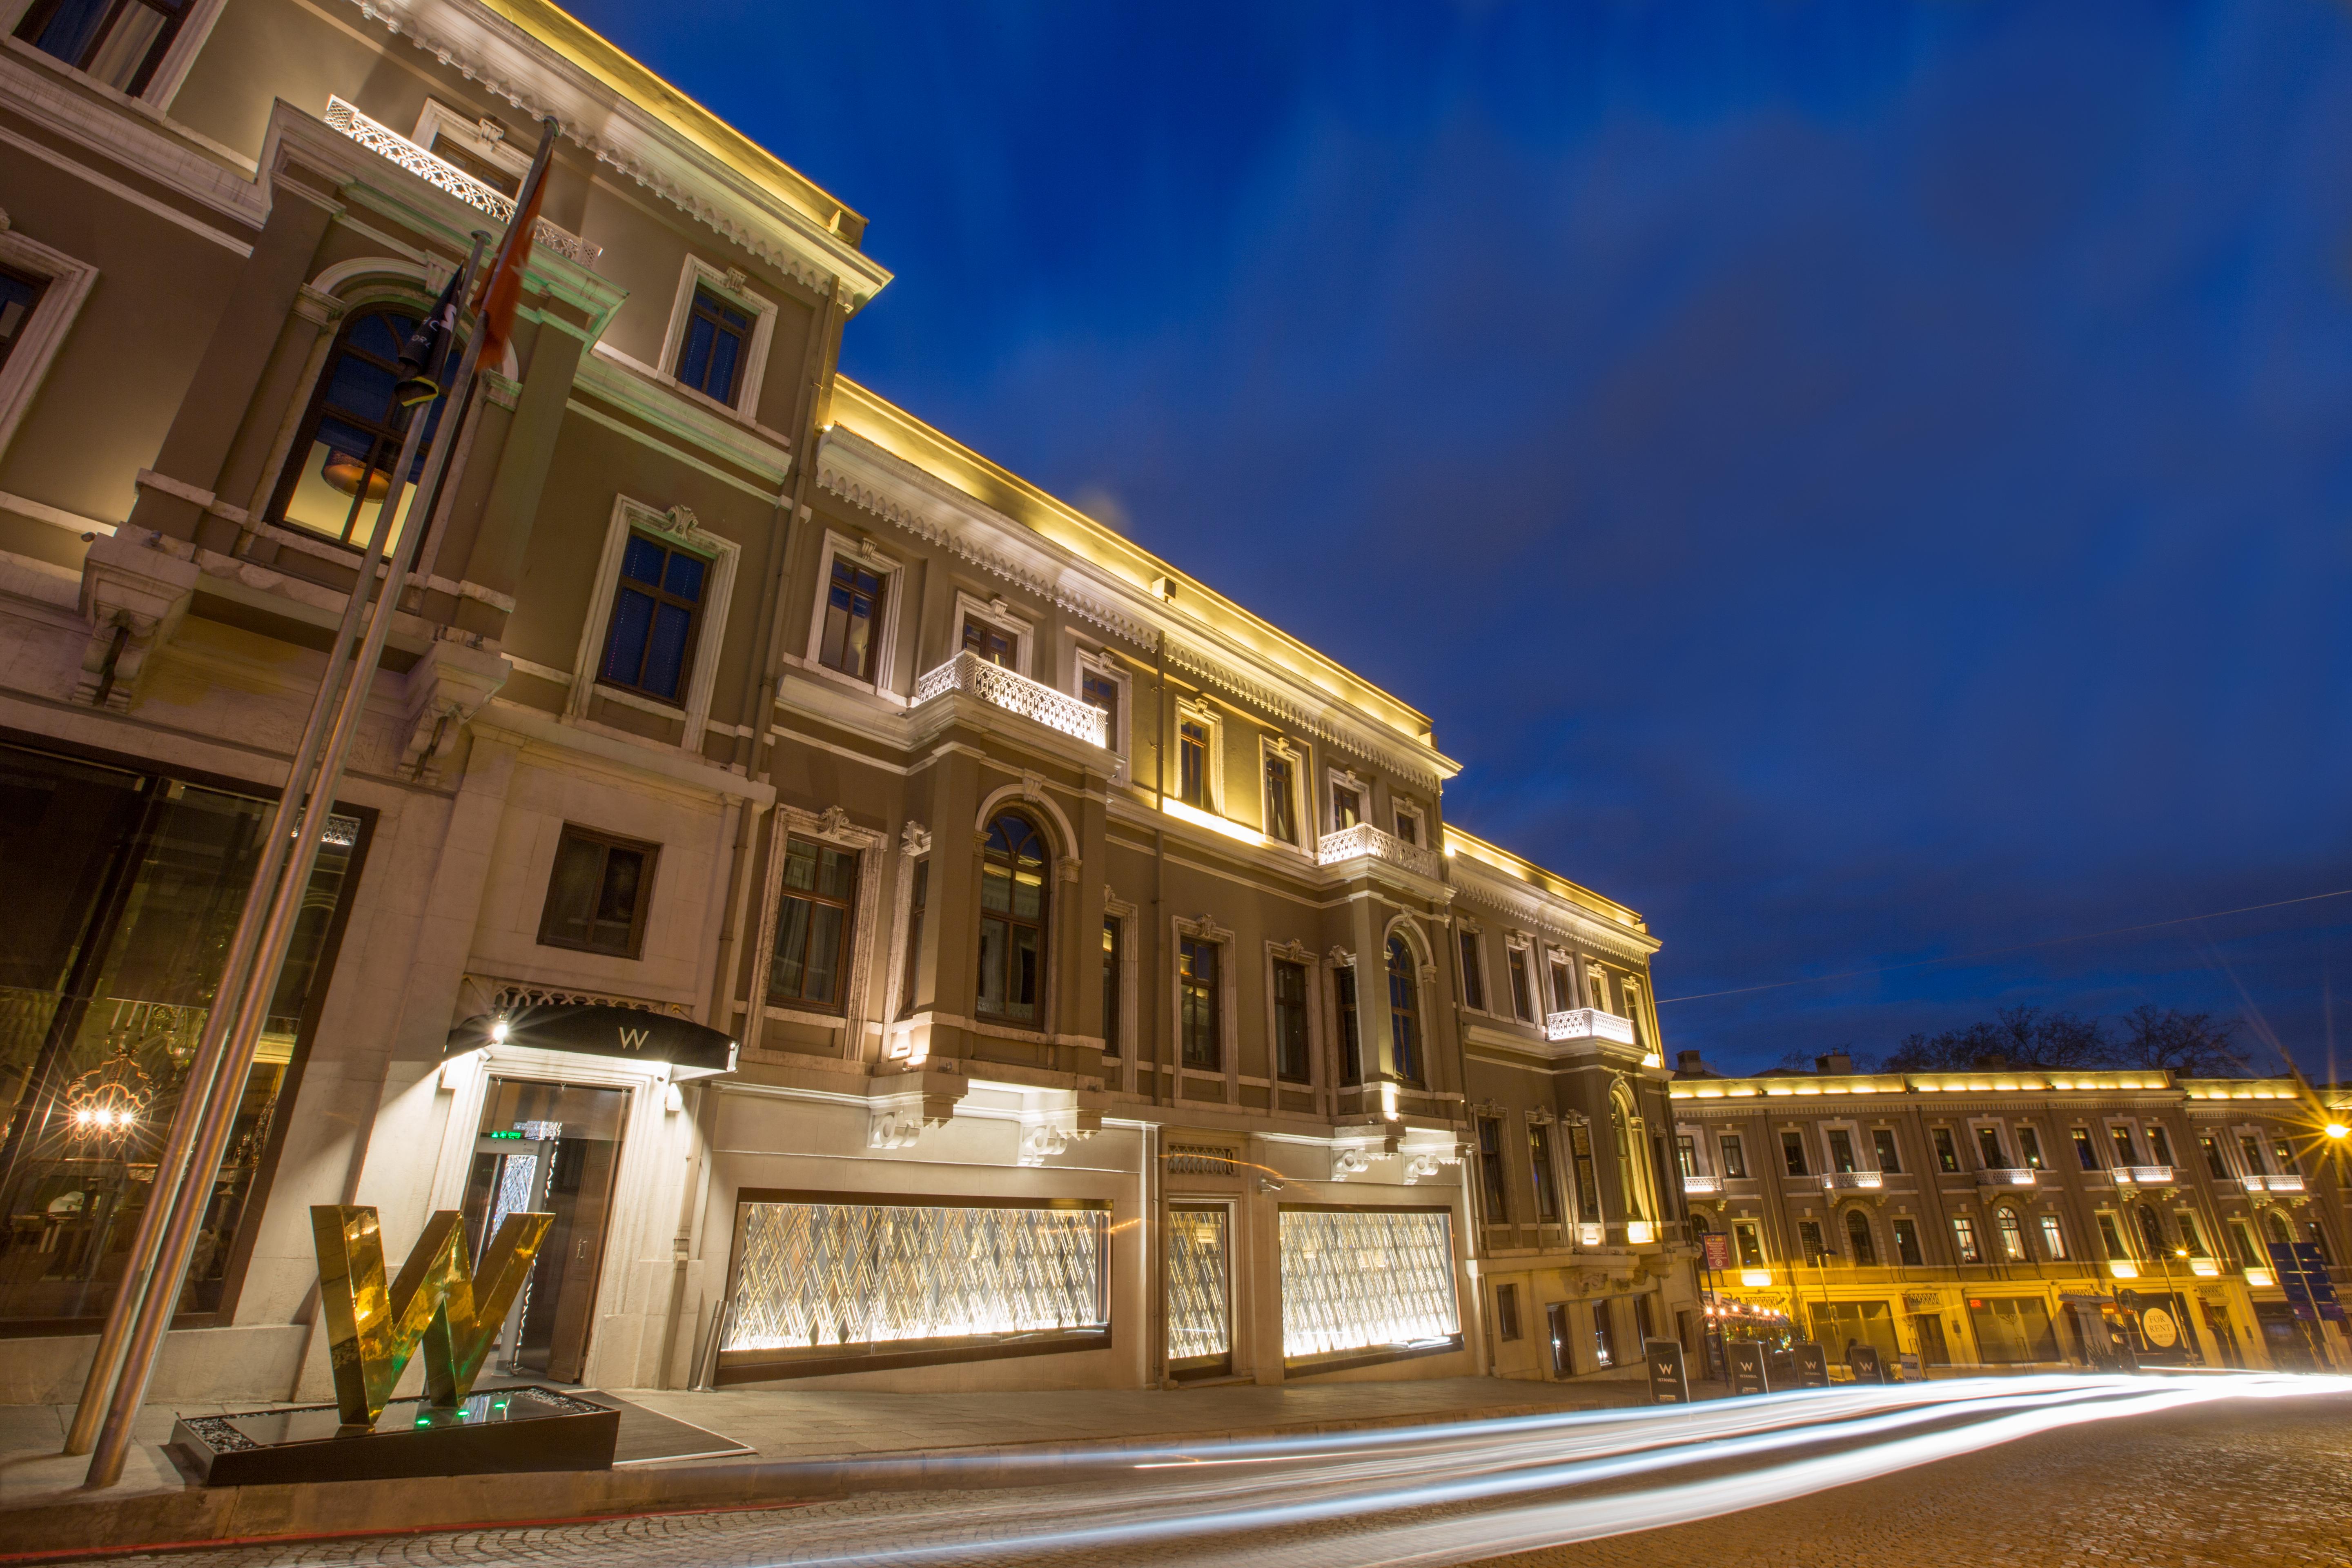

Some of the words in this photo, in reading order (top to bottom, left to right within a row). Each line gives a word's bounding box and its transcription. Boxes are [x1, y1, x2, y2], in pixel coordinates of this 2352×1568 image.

[619, 1027, 649, 1051] W
[310, 1205, 556, 1426] W
[2148, 1315, 2165, 1323] FOR
[2149, 1324, 2171, 1332] RENT
[1658, 1363, 1673, 1375] W
[1740, 1362, 1753, 1372] W
[1805, 1361, 1817, 1370] W
[1859, 1362, 1873, 1371] W
